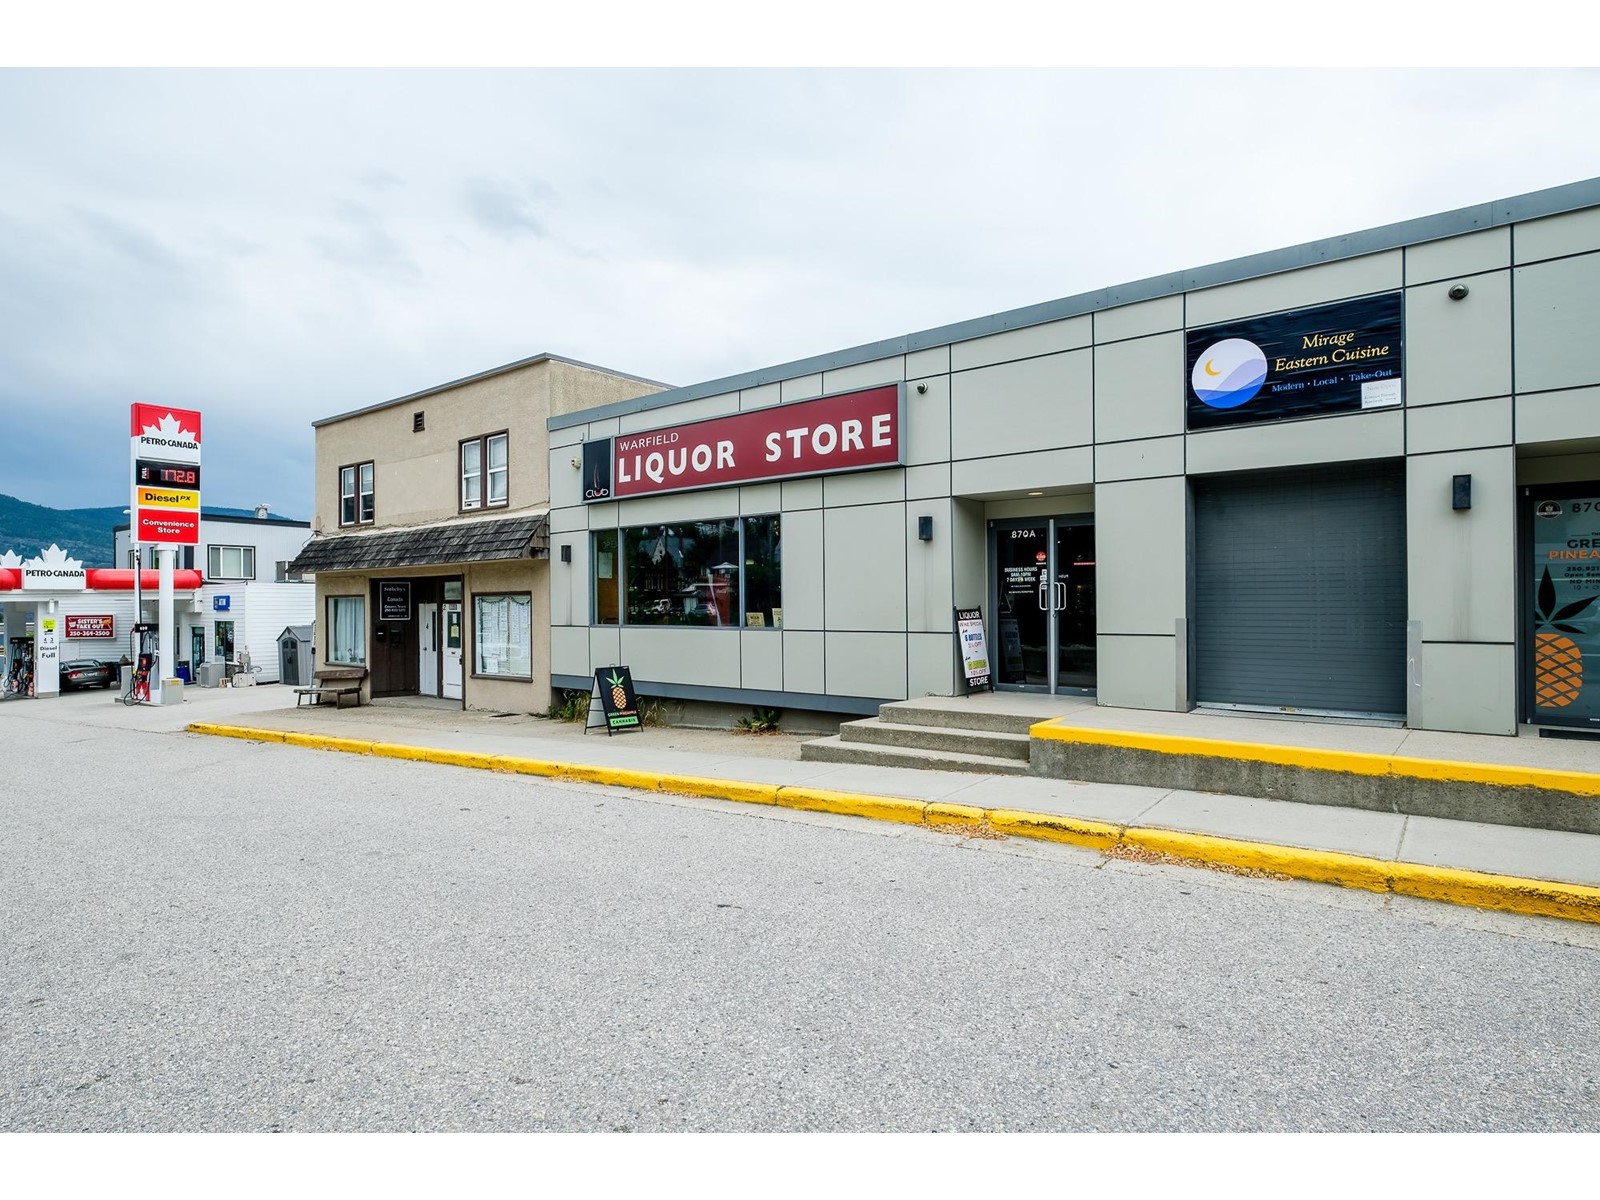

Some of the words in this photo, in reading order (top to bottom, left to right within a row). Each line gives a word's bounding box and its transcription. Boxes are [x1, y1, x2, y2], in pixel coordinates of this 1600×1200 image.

[1302, 332, 1355, 349] Mirage
[1275, 354, 1328, 372] Eastern
[1331, 345, 1389, 363] Cuisine
[1272, 382, 1304, 393] Modern
[1313, 377, 1338, 386] Local
[1349, 369, 1392, 381] Take-Out
[618, 440, 736, 484] LIQUOR
[765, 413, 892, 462] STORE
[619, 432, 679, 452] WARFIELD
[161, 469, 196, 484] 172.8
[145, 493, 179, 503] Diesel
[142, 519, 195, 528] Convenience
[1011, 530, 1036, 539] 870A
[958, 610, 980, 620] LIQUOR
[969, 676, 988, 687] STORE
